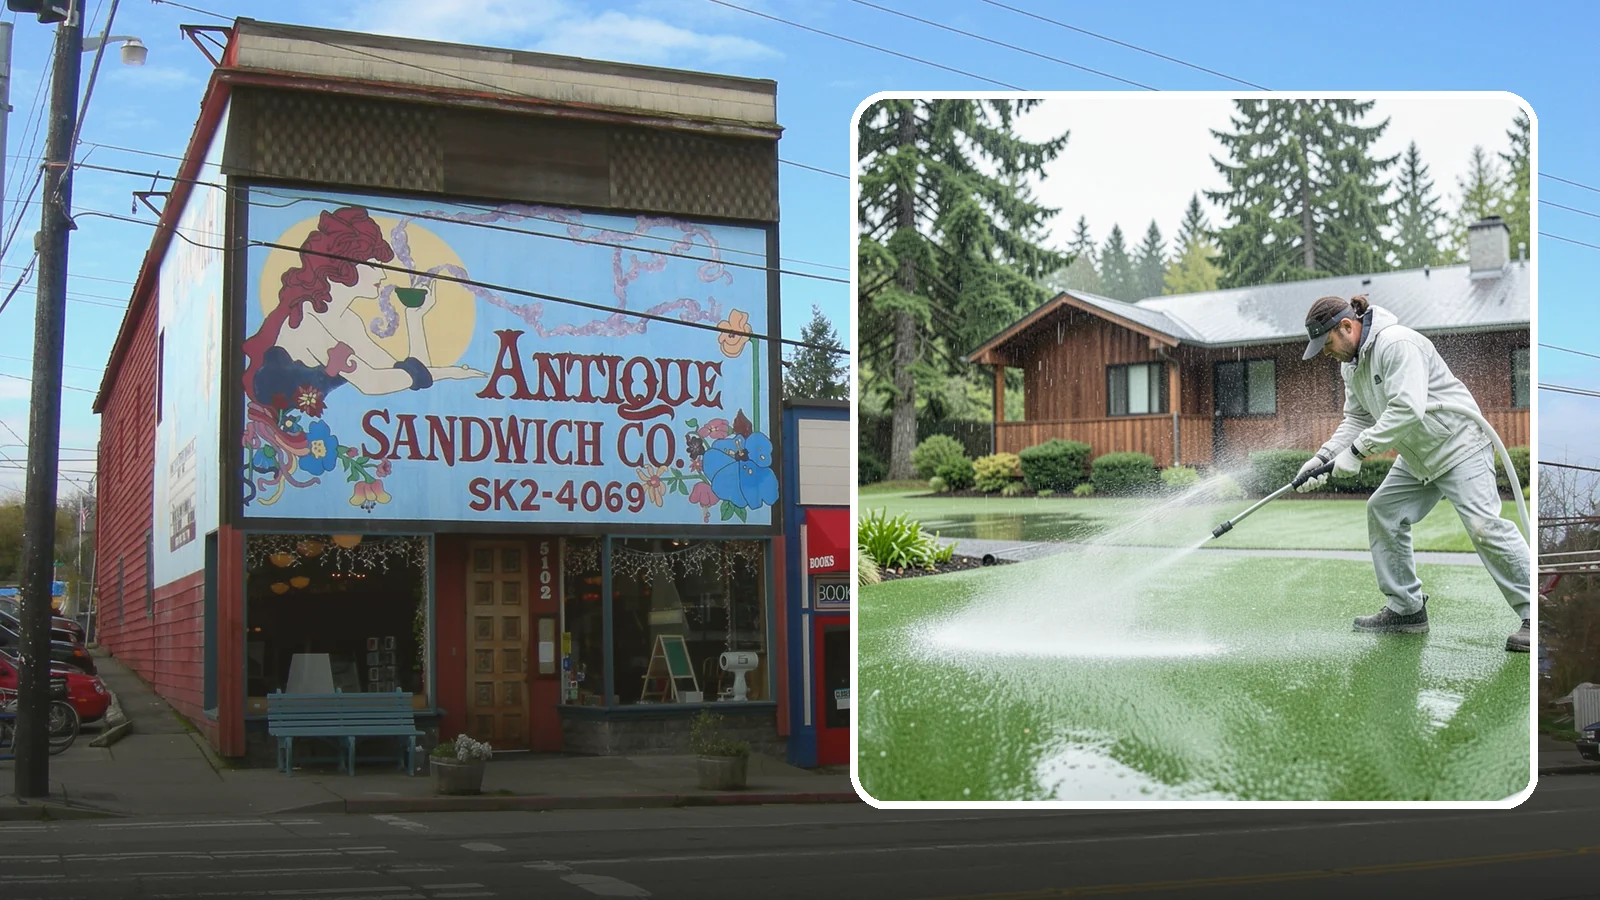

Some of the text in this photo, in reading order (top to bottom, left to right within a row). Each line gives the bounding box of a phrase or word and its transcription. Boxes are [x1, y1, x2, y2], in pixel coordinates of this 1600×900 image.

[476, 329, 724, 421] ANTIQUE
[361, 408, 685, 468] SANDWICH CO.
[468, 477, 645, 513] SK2-4069
[540, 541, 551, 600] 5102
[809, 555, 835, 569] BOOKS
